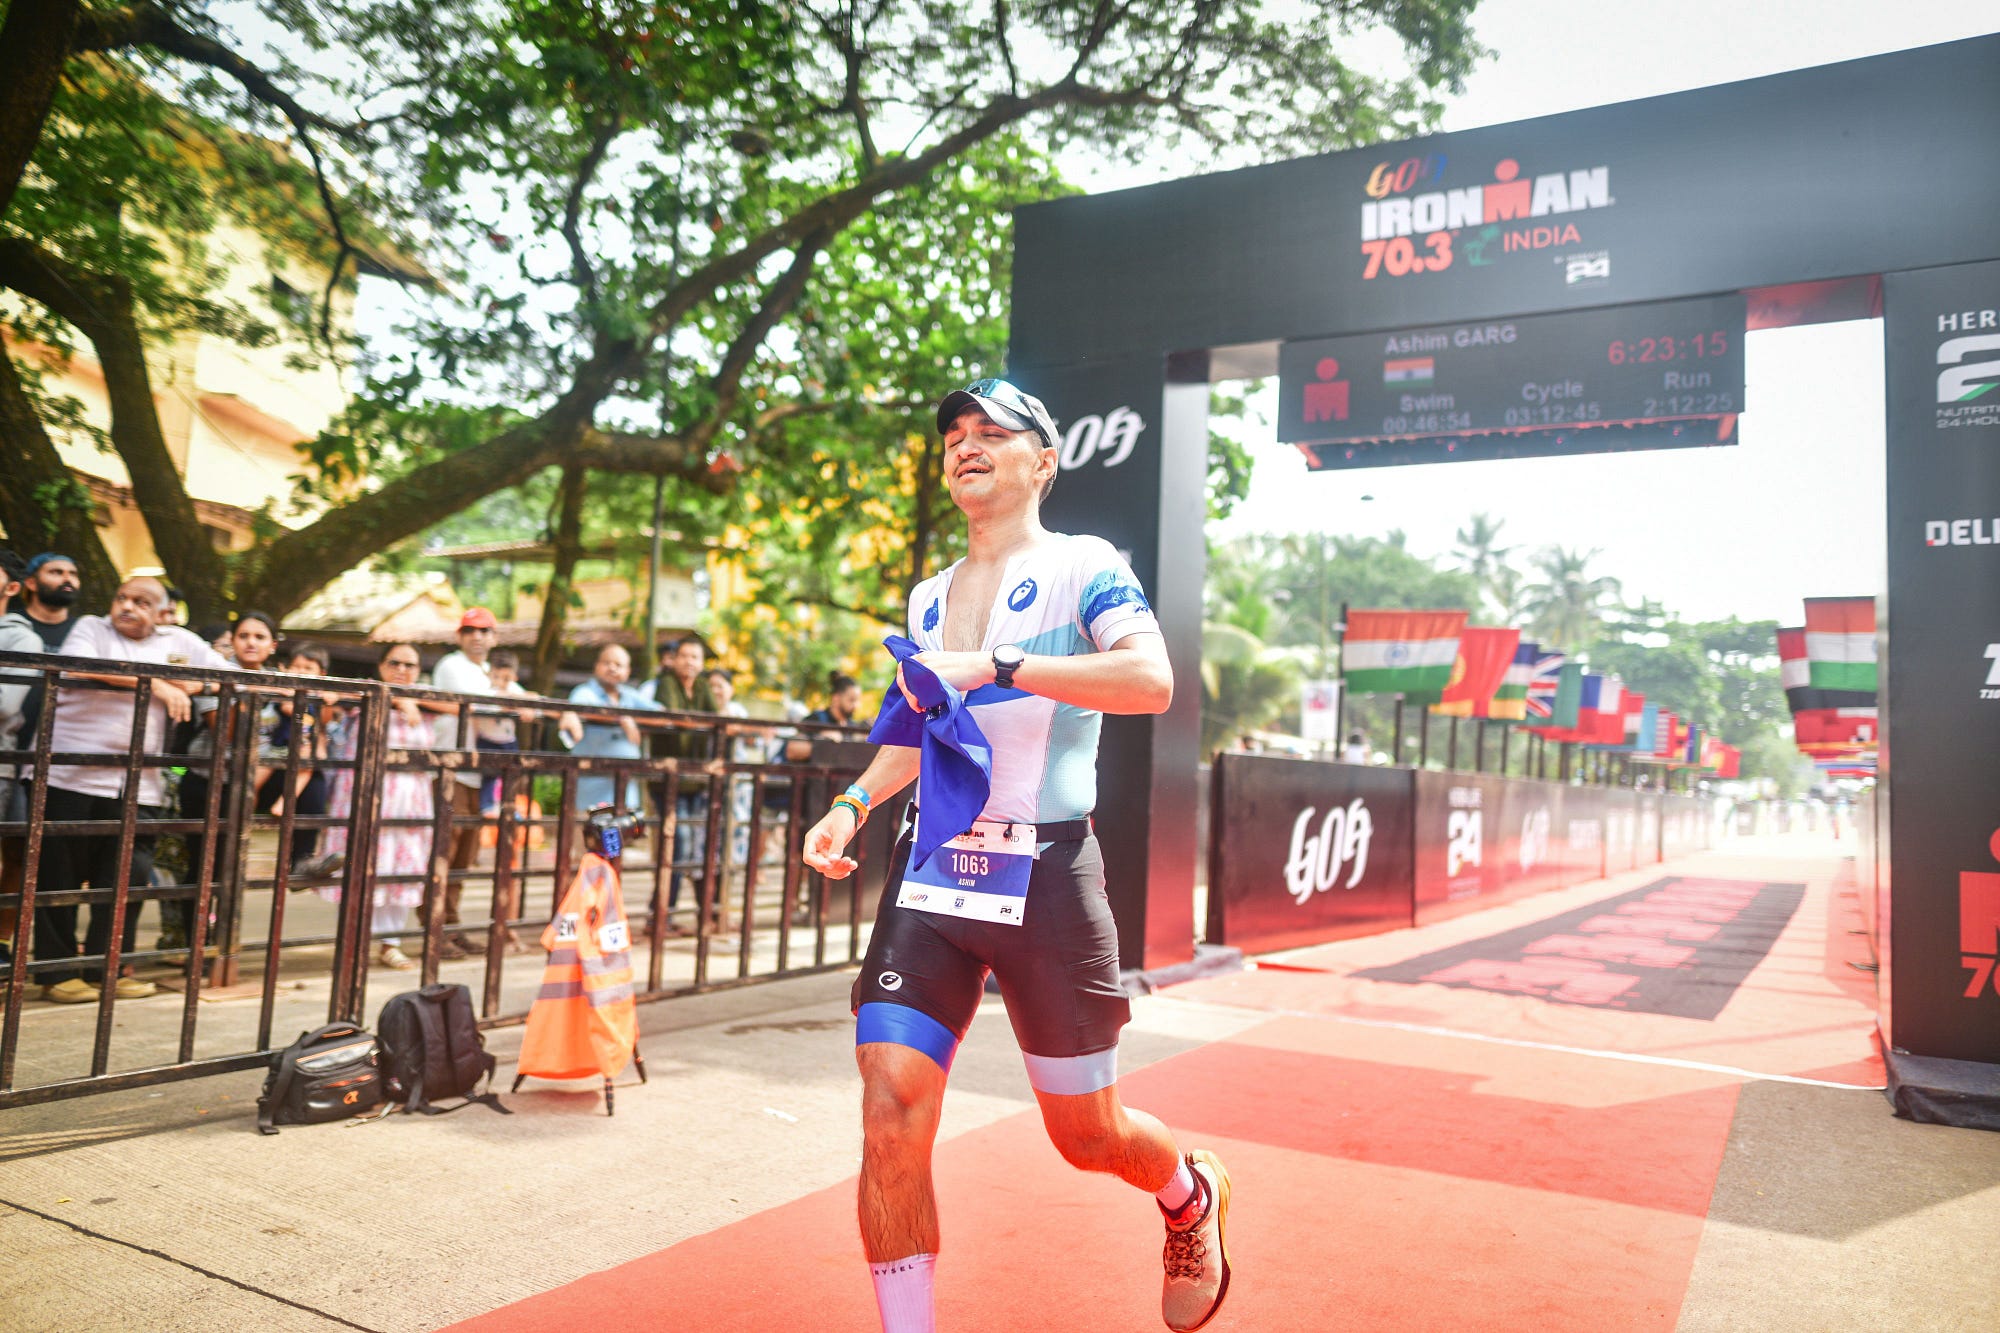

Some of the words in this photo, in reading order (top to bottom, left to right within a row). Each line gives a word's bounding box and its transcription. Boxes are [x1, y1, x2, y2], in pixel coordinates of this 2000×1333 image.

[1361, 159, 1609, 241] IRONMAN
[1503, 223, 1582, 252] INDIA
[1361, 231, 1454, 280] 70.3
[1938, 309, 2000, 332] HER
[1385, 334, 1449, 355] Ashim
[1454, 324, 1518, 347] GARG
[1608, 331, 1728, 365] 6:23:15
[1522, 379, 1584, 405] Cycle
[1664, 371, 1712, 390] Run
[1401, 394, 1455, 413] Swim
[951, 853, 989, 876] 1063
[958, 878, 976, 887] ASHIM
